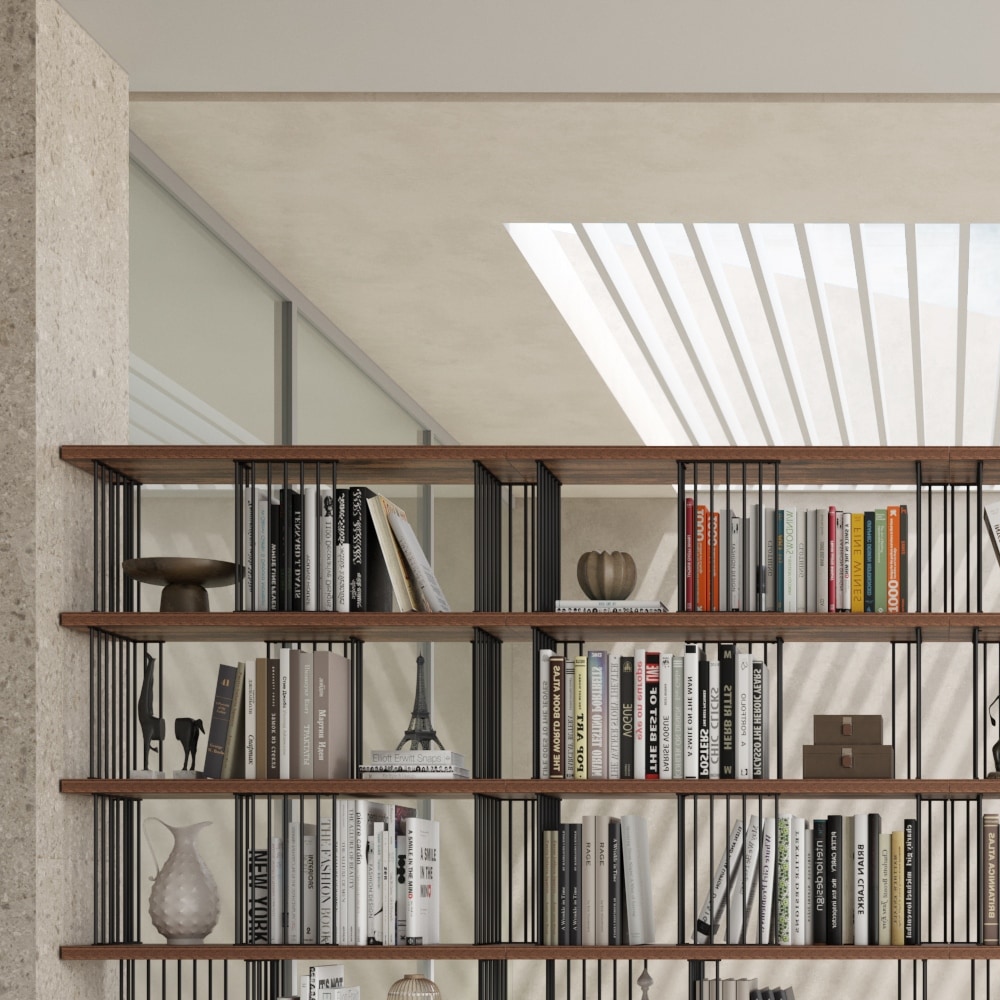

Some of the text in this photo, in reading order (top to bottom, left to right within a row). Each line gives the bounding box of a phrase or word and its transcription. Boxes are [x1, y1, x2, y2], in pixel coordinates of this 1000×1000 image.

[888, 579, 899, 613] 1000
[317, 709, 326, 761] Мартин Иден
[372, 754, 442, 764] Elliott Erwitt Snaps
[248, 850, 268, 944] NEW YORK
[320, 819, 331, 943] THE FASHION BOOK
